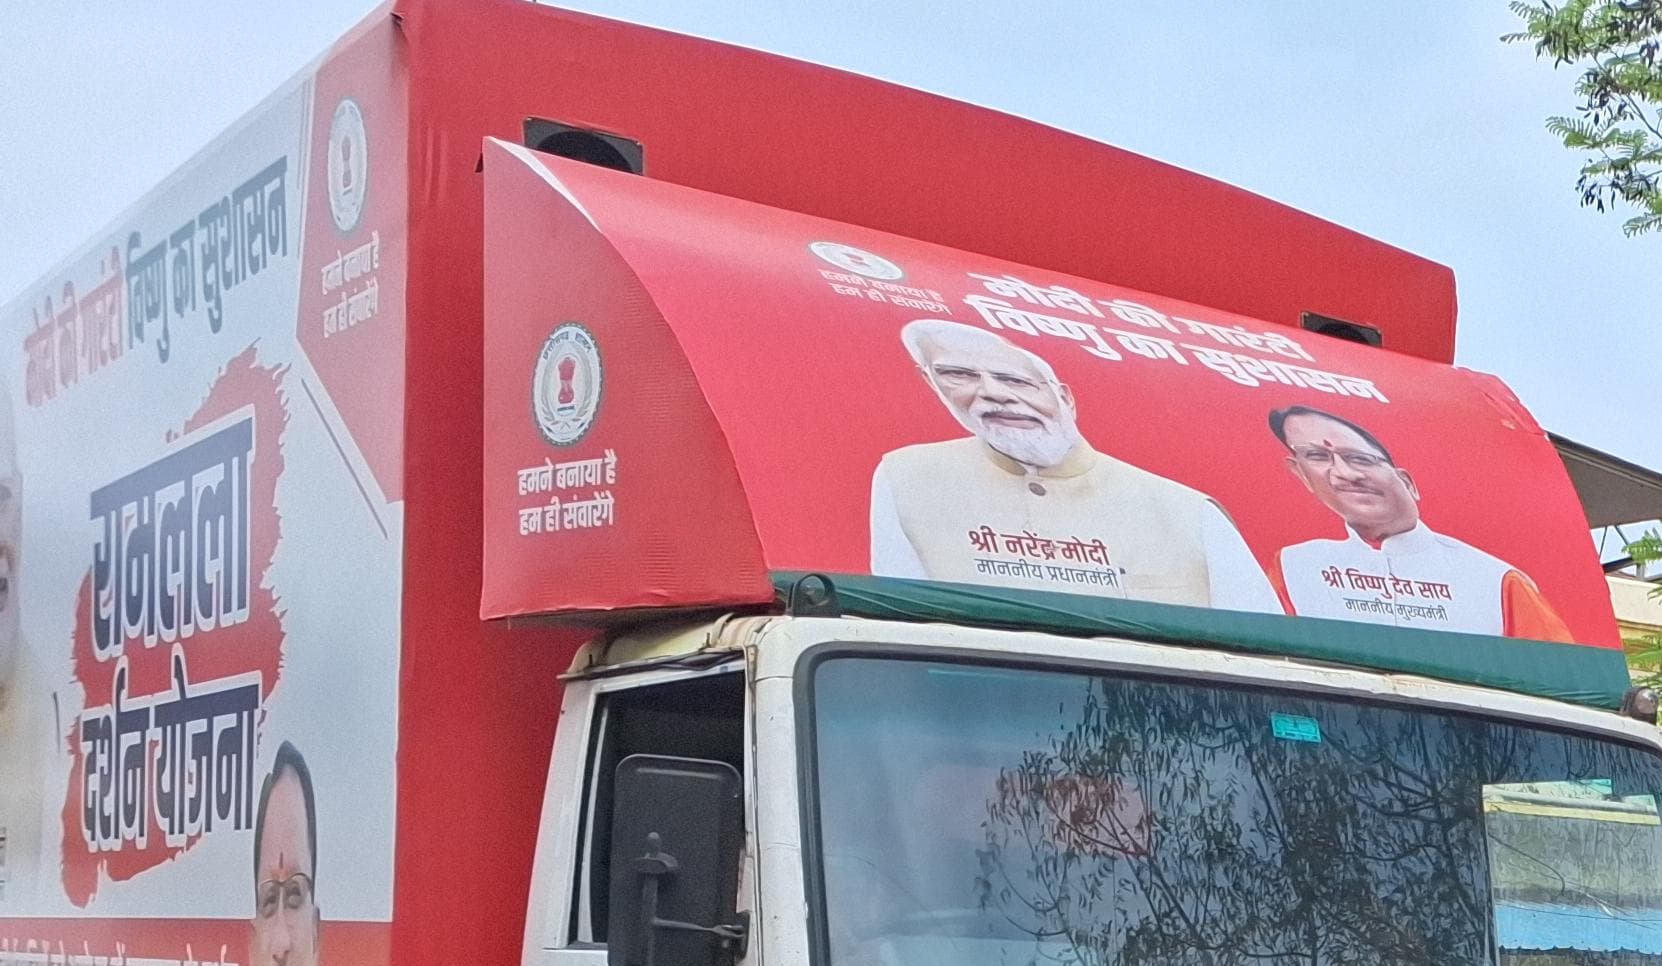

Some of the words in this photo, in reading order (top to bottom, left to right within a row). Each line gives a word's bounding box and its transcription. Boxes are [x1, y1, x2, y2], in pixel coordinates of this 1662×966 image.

[126, 231, 169, 364] विष्णु
[169, 219, 196, 319] का
[197, 155, 288, 335] सुशासन
[967, 272, 1105, 318] मोदी
[1097, 299, 1181, 334] की
[1172, 316, 1316, 362] गारंटी
[962, 294, 1123, 361] विष्णु
[1102, 327, 1190, 365] का
[1182, 344, 1390, 404] सुशासन
[518, 456, 554, 495] हमने
[555, 457, 603, 490] बनाया
[603, 448, 618, 484] है
[90, 416, 253, 652] रामलला
[519, 507, 542, 536] हम
[544, 496, 560, 532] ही
[562, 490, 615, 529] संवारेंगे
[968, 525, 999, 553] श्री
[1001, 530, 1055, 560] नरेंद्र
[1057, 536, 1110, 566] मोदी
[974, 558, 1043, 580] माननीय
[1045, 565, 1119, 589] प्रधानमंत्री
[1321, 565, 1345, 589] श्री
[1344, 568, 1393, 599] विष्णु
[1389, 571, 1415, 597] देव
[1414, 580, 1453, 601] साय
[1343, 597, 1395, 615] माननीय
[1395, 602, 1449, 622] मुख्यमंत्री
[80, 660, 151, 843] दर्शन
[151, 652, 261, 836] योजना
